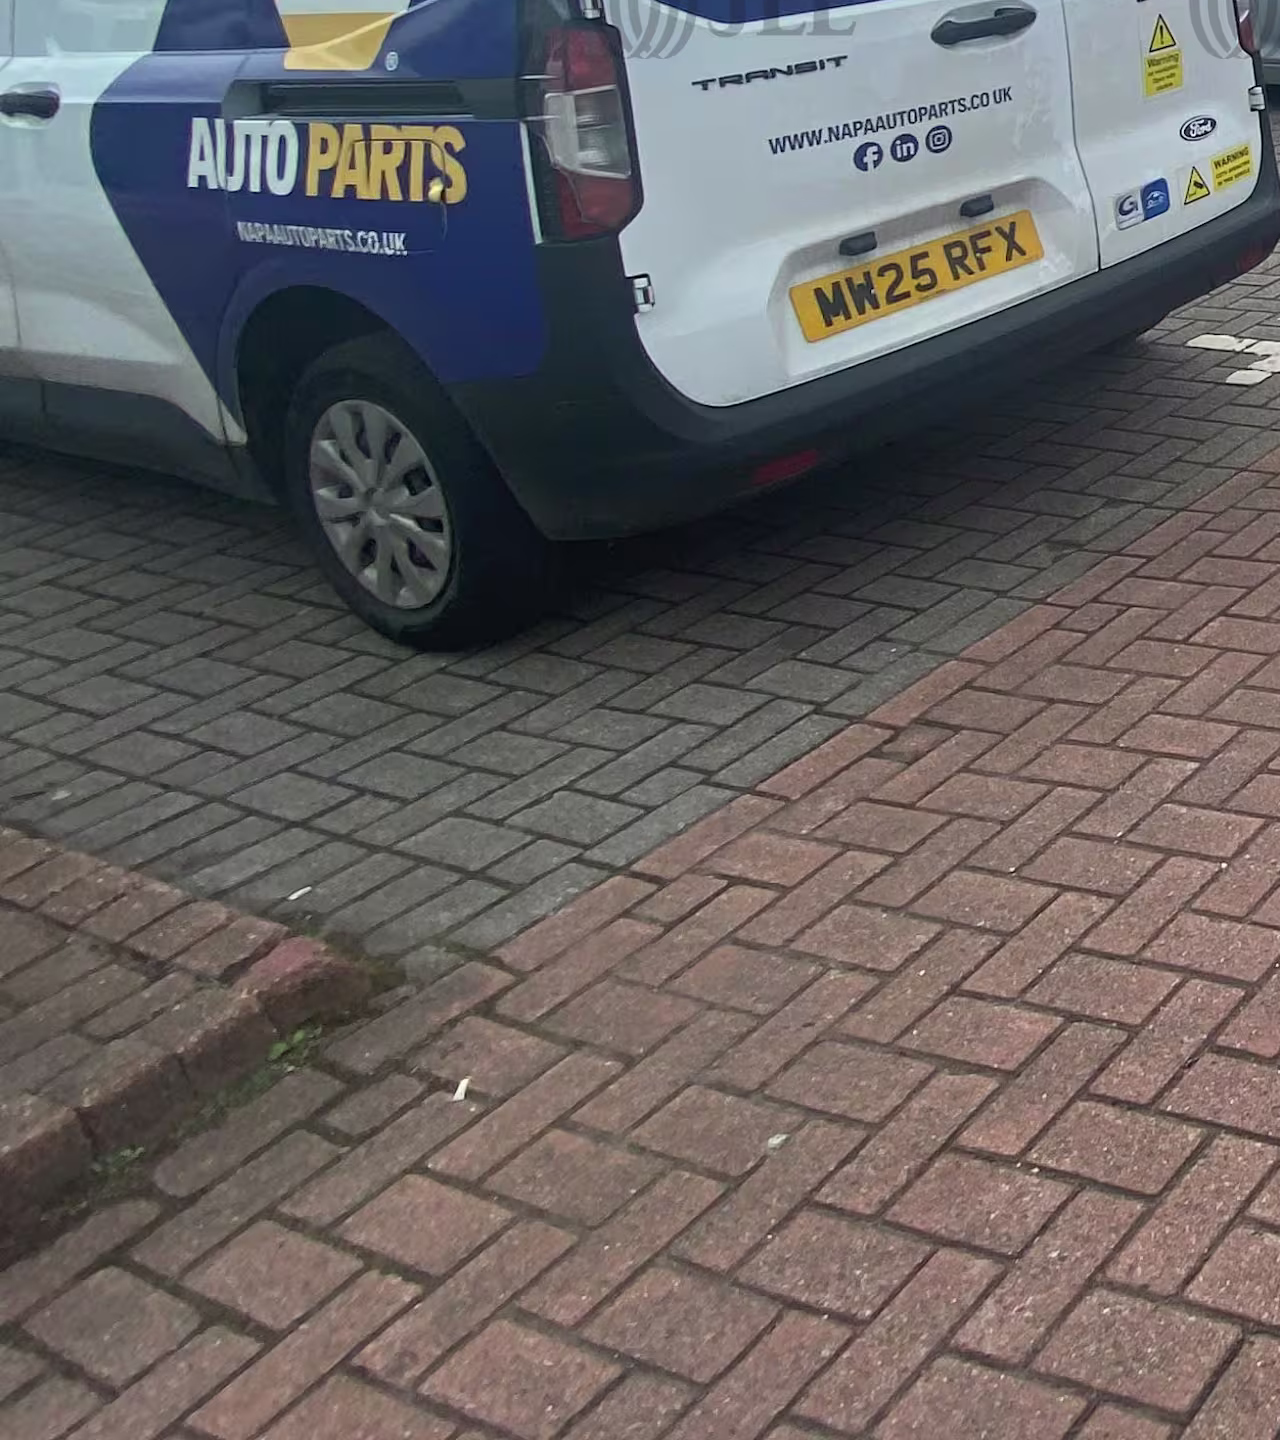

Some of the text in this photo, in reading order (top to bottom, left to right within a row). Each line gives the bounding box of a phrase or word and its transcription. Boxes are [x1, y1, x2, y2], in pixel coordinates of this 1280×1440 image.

[691, 55, 848, 91] TRANSIT
[1189, 117, 1214, 138] Ford
[187, 117, 468, 205] AUTO PARTS
[1213, 146, 1249, 170] WARNING
[236, 220, 408, 257] NAPAAUTOPARTS.CO.UK
[813, 220, 1027, 328] MW25 RFX
